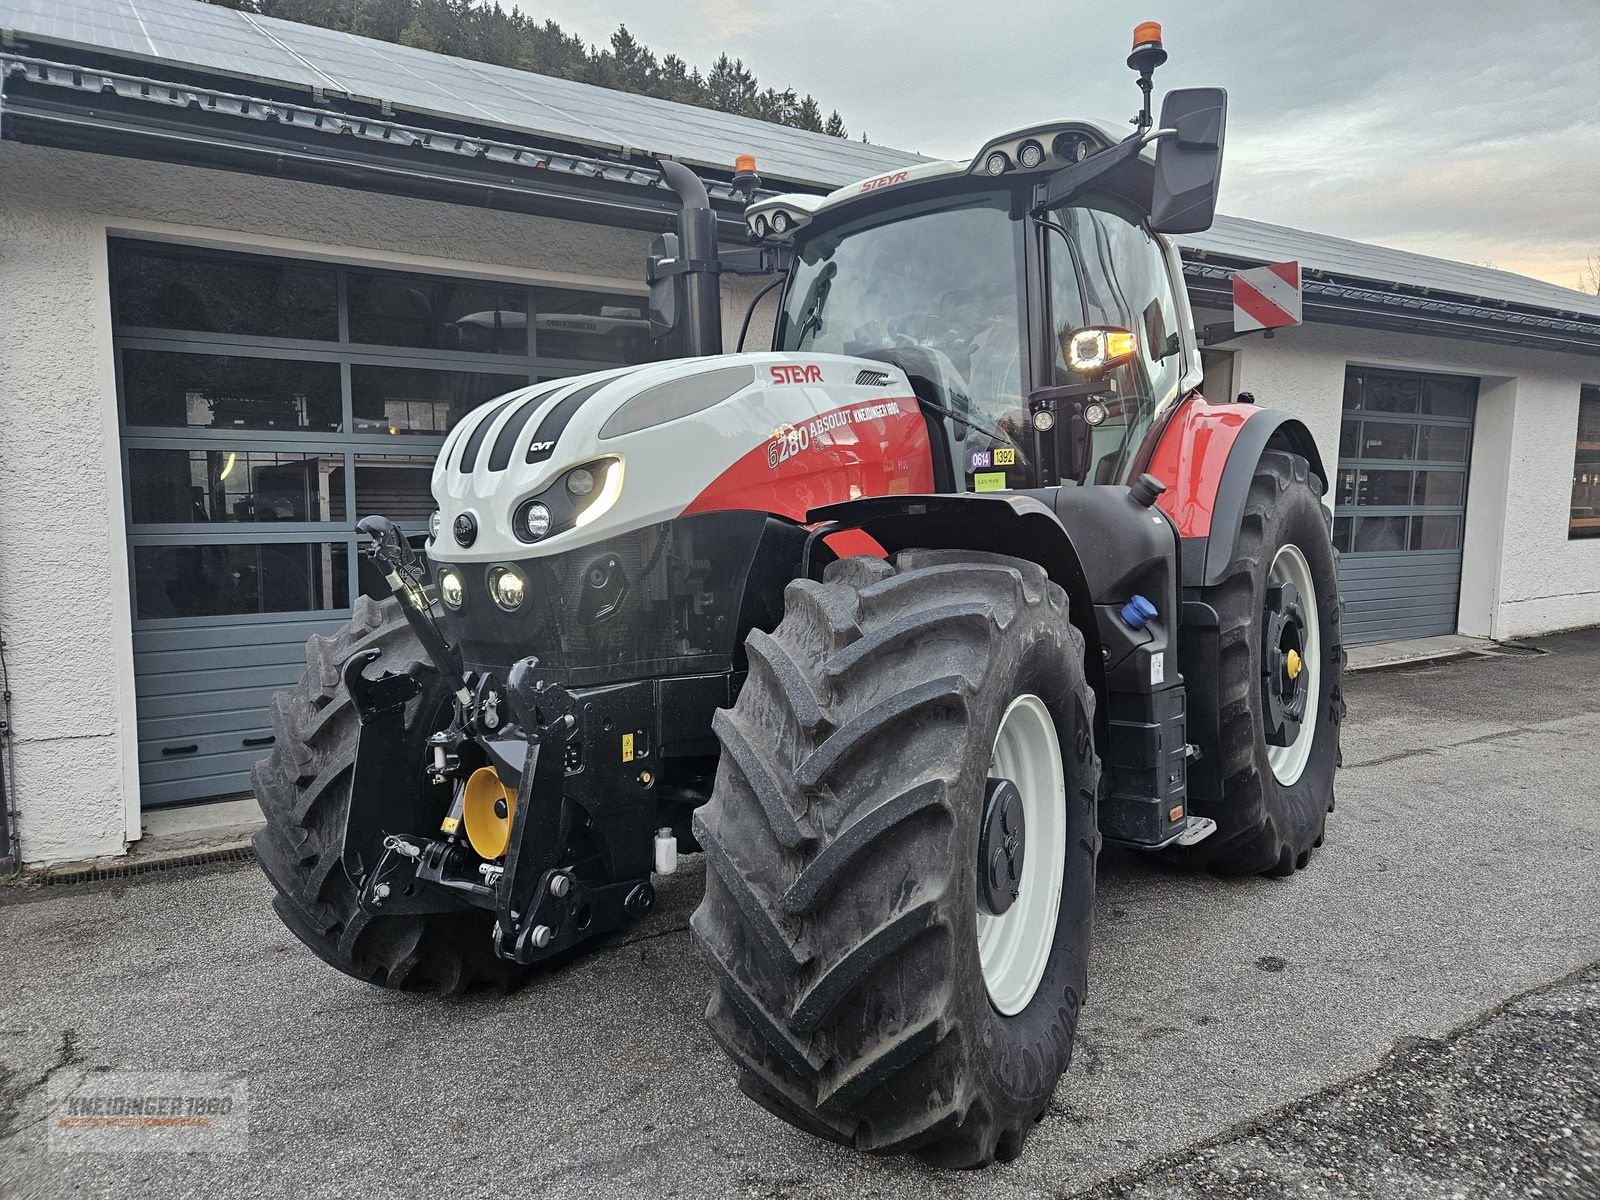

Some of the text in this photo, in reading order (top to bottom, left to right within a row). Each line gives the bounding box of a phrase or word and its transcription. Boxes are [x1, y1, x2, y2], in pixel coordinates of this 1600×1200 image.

[860, 171, 908, 192] STEYR
[769, 365, 824, 385] STEYR
[530, 440, 555, 451] CVT
[767, 425, 809, 469] 6280
[810, 410, 852, 438] ABSOLUT
[972, 453, 989, 466] 0614
[995, 450, 1013, 463] 1392
